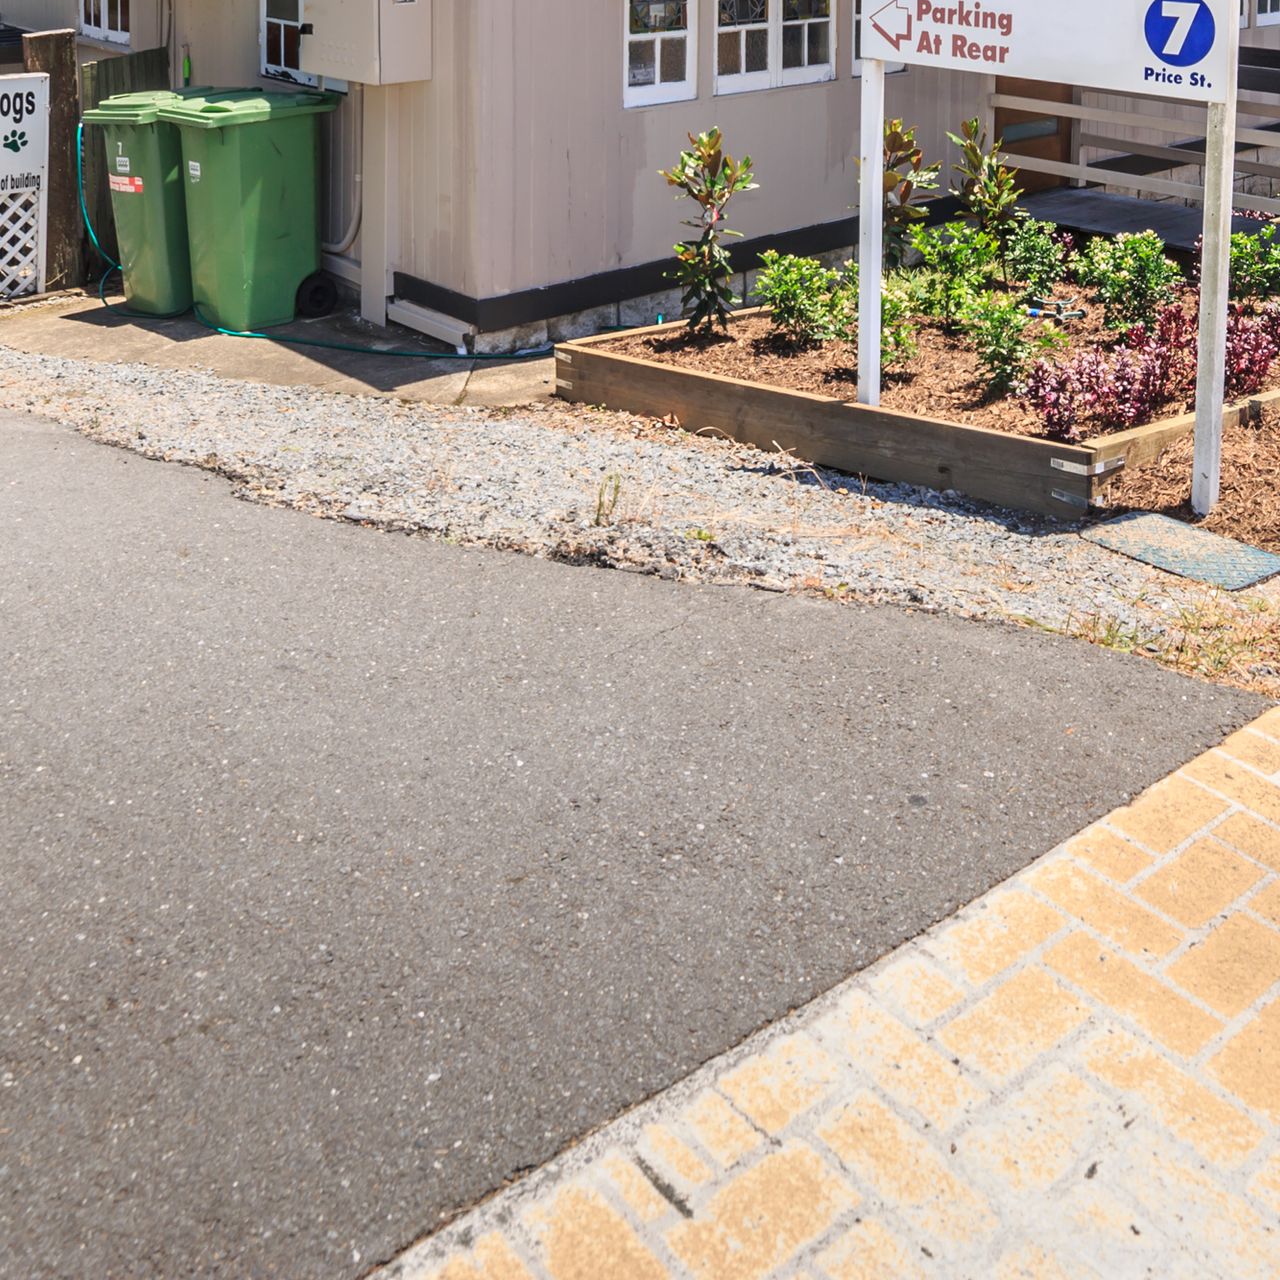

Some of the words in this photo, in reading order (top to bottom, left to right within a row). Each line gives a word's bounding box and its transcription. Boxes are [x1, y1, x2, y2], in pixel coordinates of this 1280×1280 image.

[1161, 0, 1201, 55] 7
[917, 31, 943, 54] At
[952, 35, 1010, 64] Rear
[1144, 67, 1183, 86] Price
[1190, 71, 1212, 89] St.
[0, 176, 9, 191] of
[10, 173, 41, 190] building
